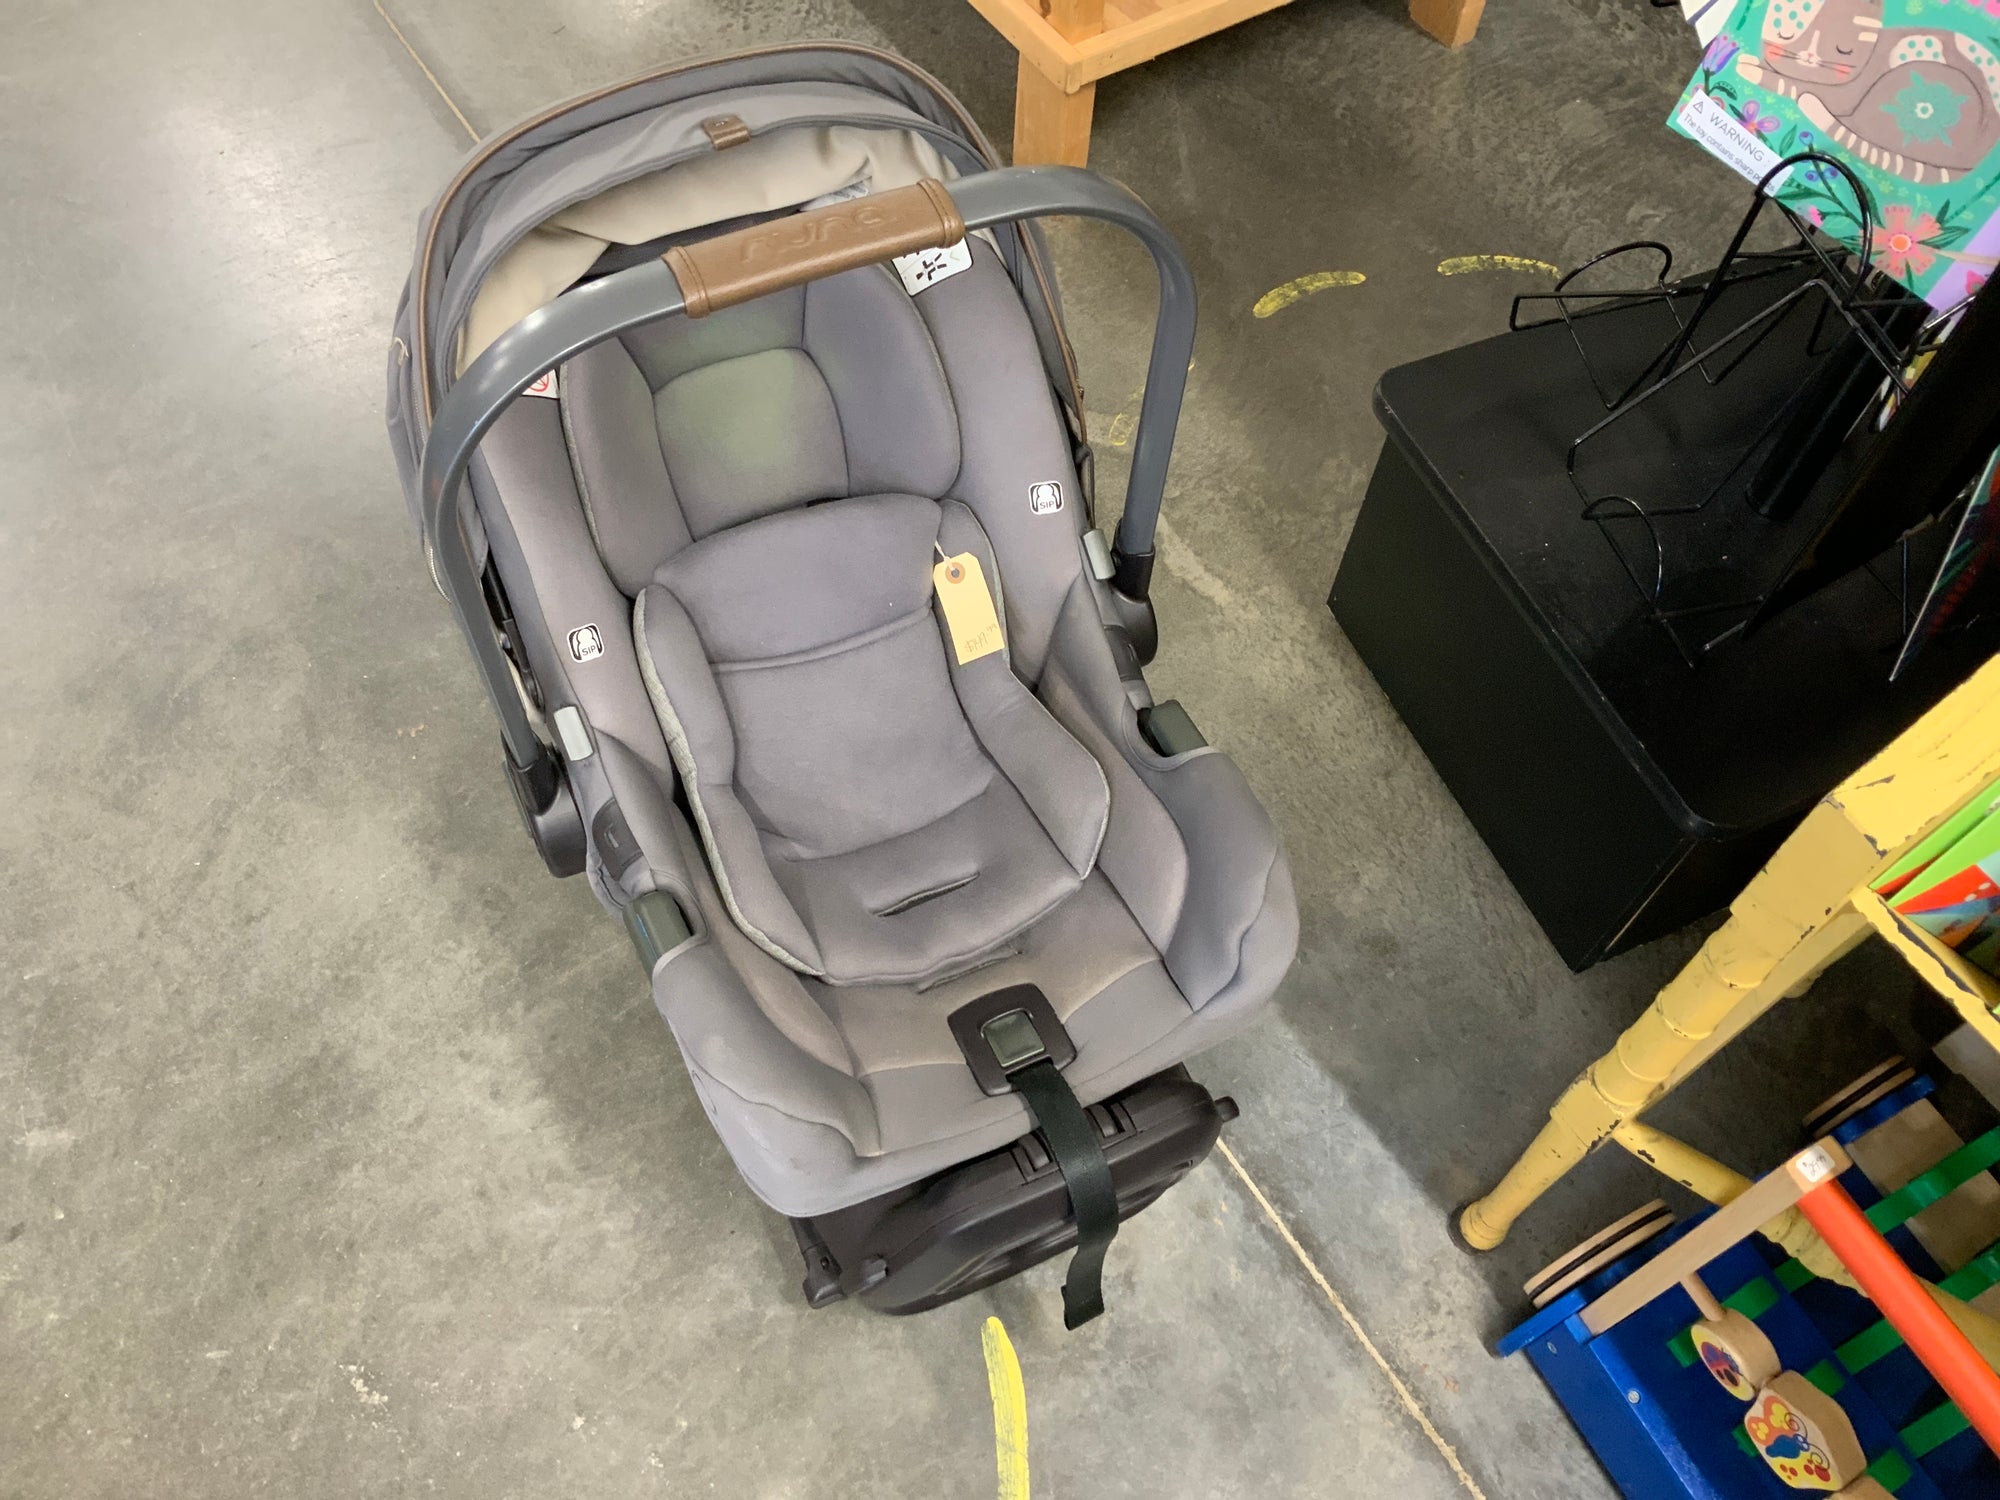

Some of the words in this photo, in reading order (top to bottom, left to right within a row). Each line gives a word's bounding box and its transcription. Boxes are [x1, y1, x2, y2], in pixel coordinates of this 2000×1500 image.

[1709, 111, 1765, 162] WARNING
[1684, 113, 1697, 128] The
[1696, 124, 1706, 138] toy
[1706, 135, 1736, 161] contains
[1735, 155, 1755, 176] sharp
[1752, 171, 1775, 192] pots
[1039, 500, 1055, 510] SIP
[581, 644, 596, 656] SIP
